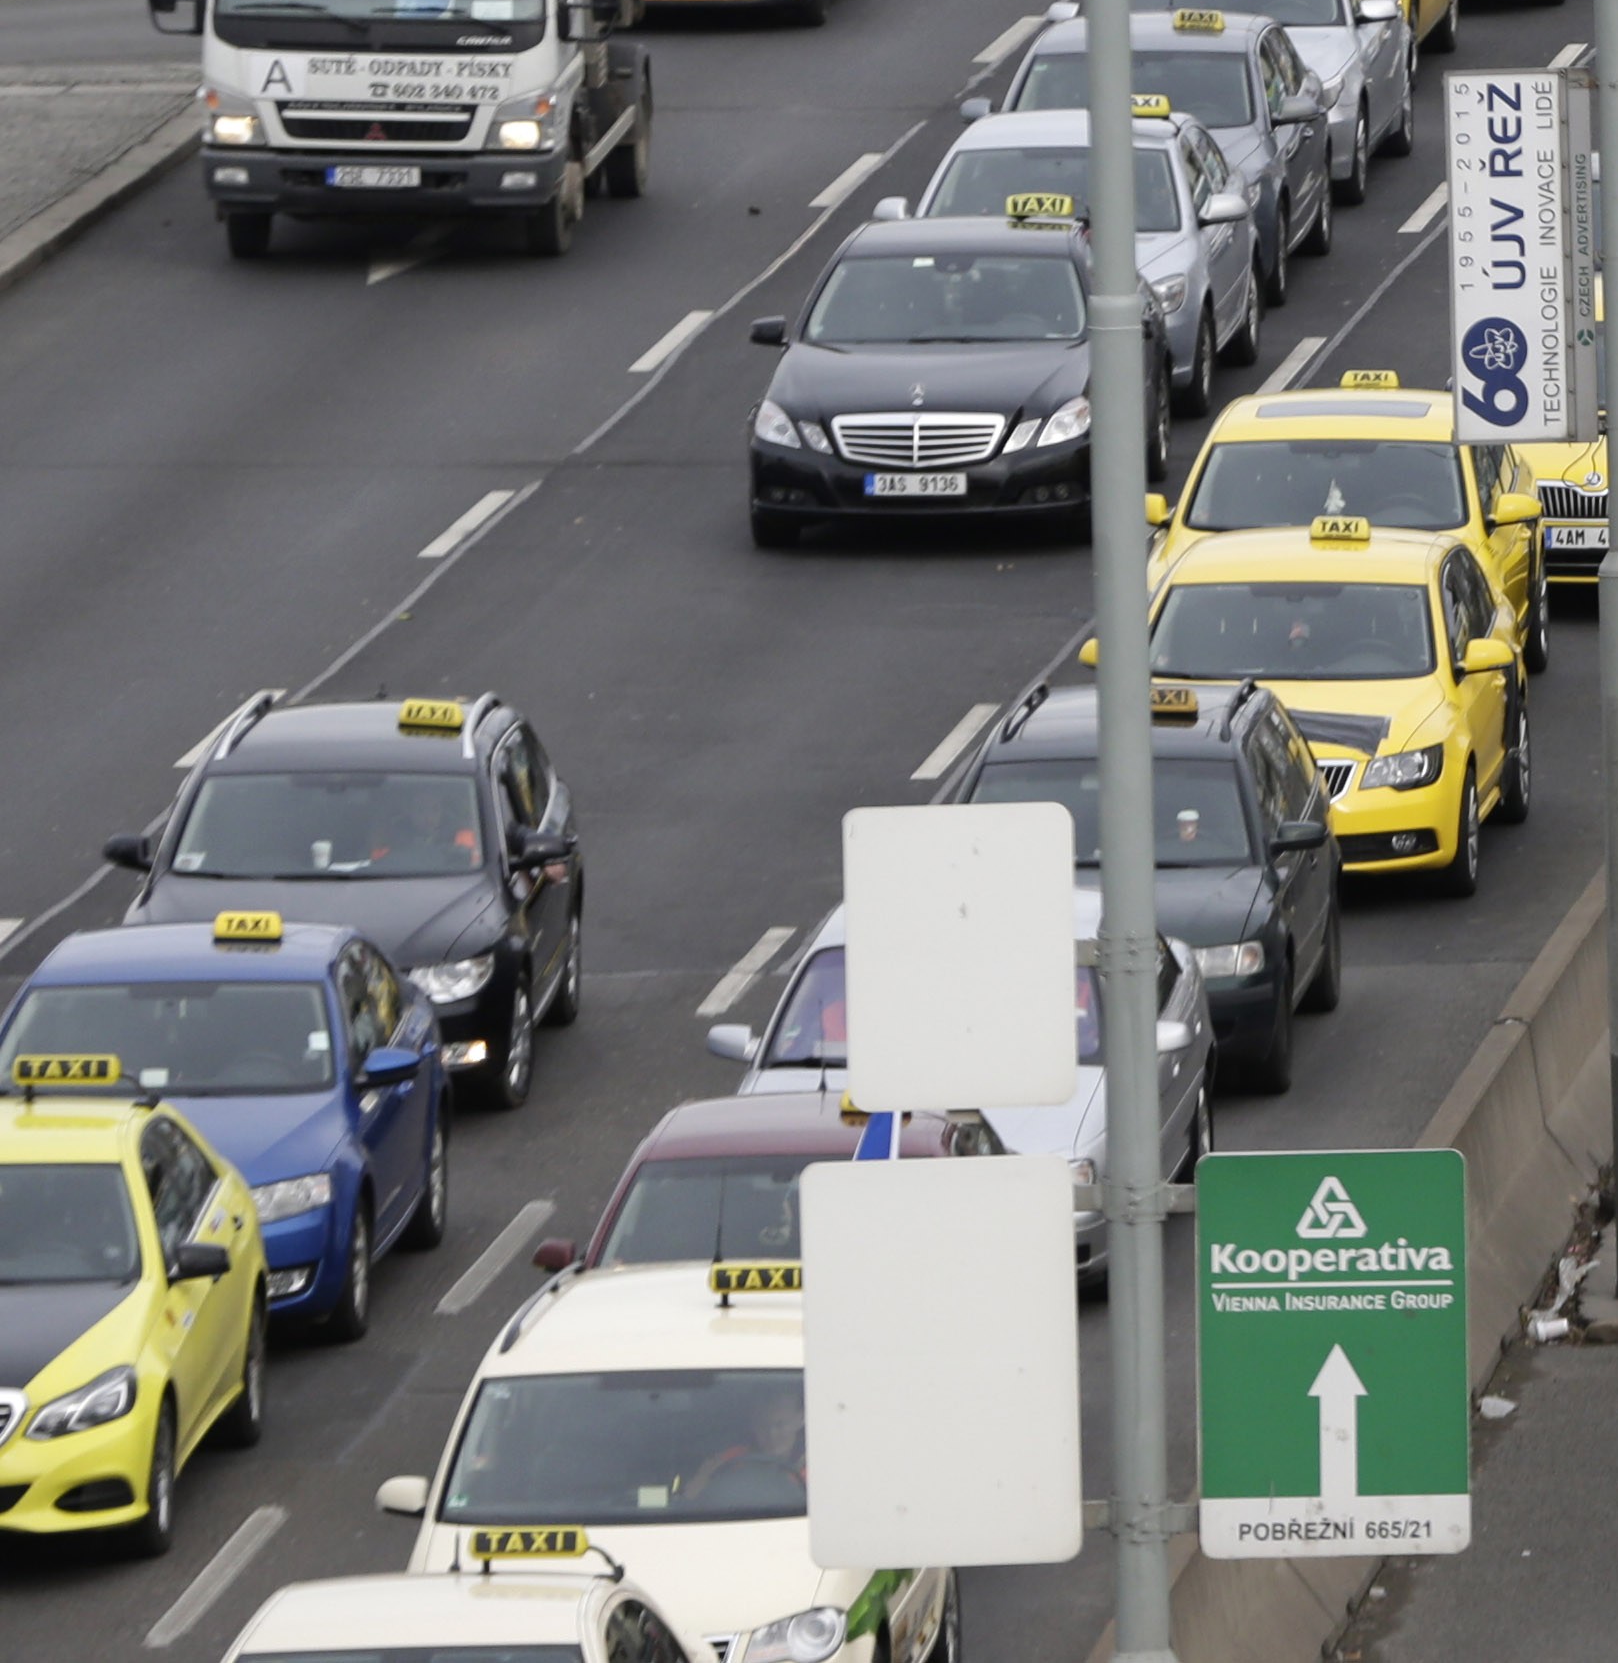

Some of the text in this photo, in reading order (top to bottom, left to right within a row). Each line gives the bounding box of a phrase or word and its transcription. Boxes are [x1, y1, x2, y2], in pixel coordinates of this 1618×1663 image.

[261, 58, 293, 94] A
[368, 58, 444, 78] ODPADY
[1477, 82, 1527, 290] ÚJV ŘEŽ
[1014, 196, 1064, 213] TAXI
[1575, 153, 1592, 318] CZECH ADVERTISING
[1531, 81, 1562, 426] TECHNOLOGIE INOVACE LIDÉ
[1352, 373, 1388, 382] TAXI
[878, 475, 958, 491] 3AS 9136
[1321, 522, 1358, 533] TAXI
[1556, 529, 1585, 545] 4AM
[227, 918, 270, 930] TAXI
[29, 1060, 100, 1078] TAXI
[1209, 1238, 1453, 1281] Kooperativa
[727, 1267, 802, 1289] TAXI
[1210, 1290, 1453, 1313] VIENNA INSURANCE GROUP
[1238, 1517, 1433, 1542] POBŘEŽNÍ 665/21
[486, 1531, 566, 1553] TAXI
